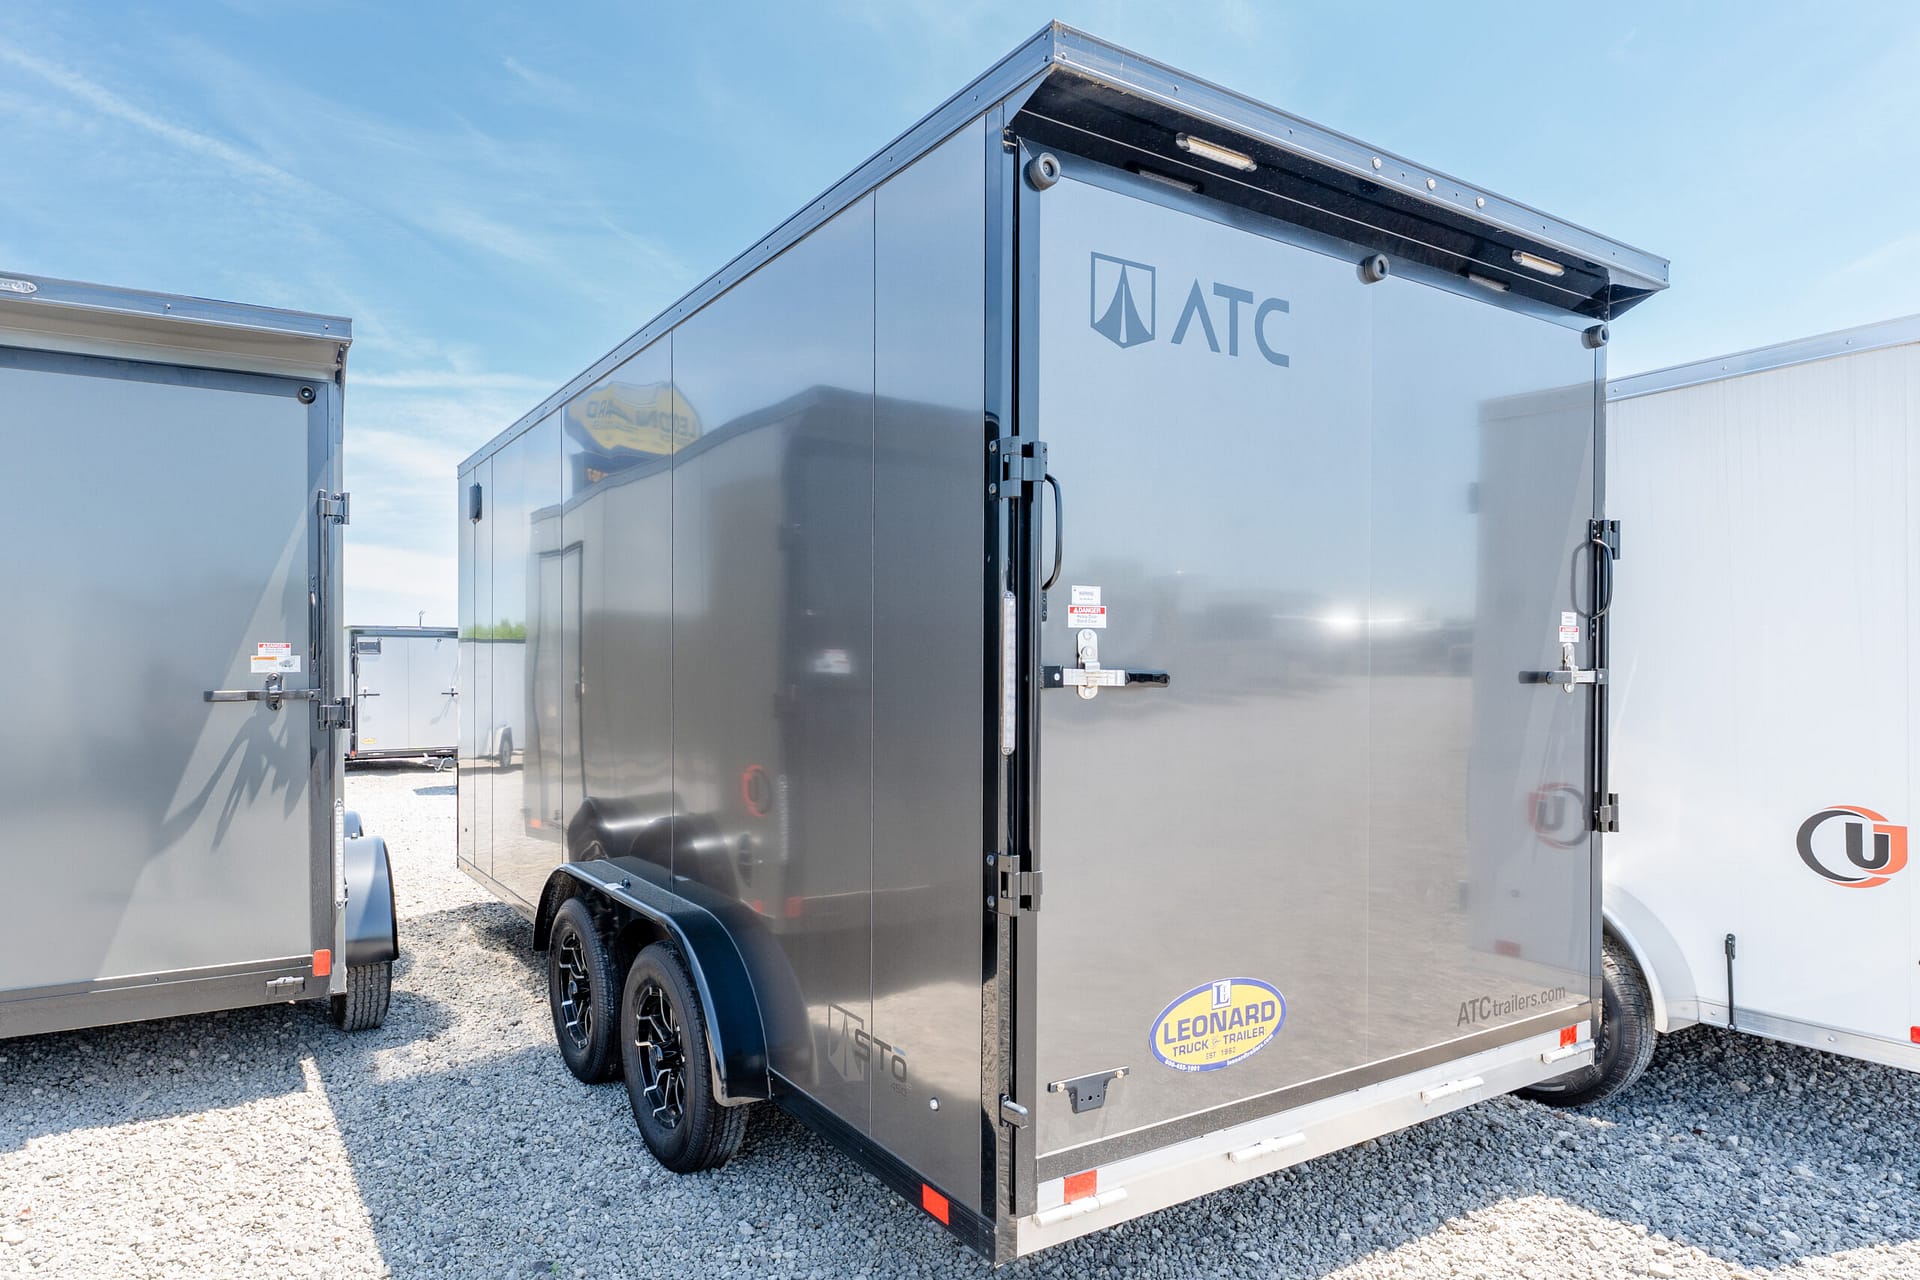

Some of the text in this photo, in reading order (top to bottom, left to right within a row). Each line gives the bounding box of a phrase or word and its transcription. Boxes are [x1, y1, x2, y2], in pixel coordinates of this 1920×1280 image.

[1171, 278, 1290, 368] ATC
[1164, 1000, 1276, 1045] LEONARD
[1172, 1038, 1209, 1057] TRUCK
[1223, 1026, 1265, 1045] TRAILER
